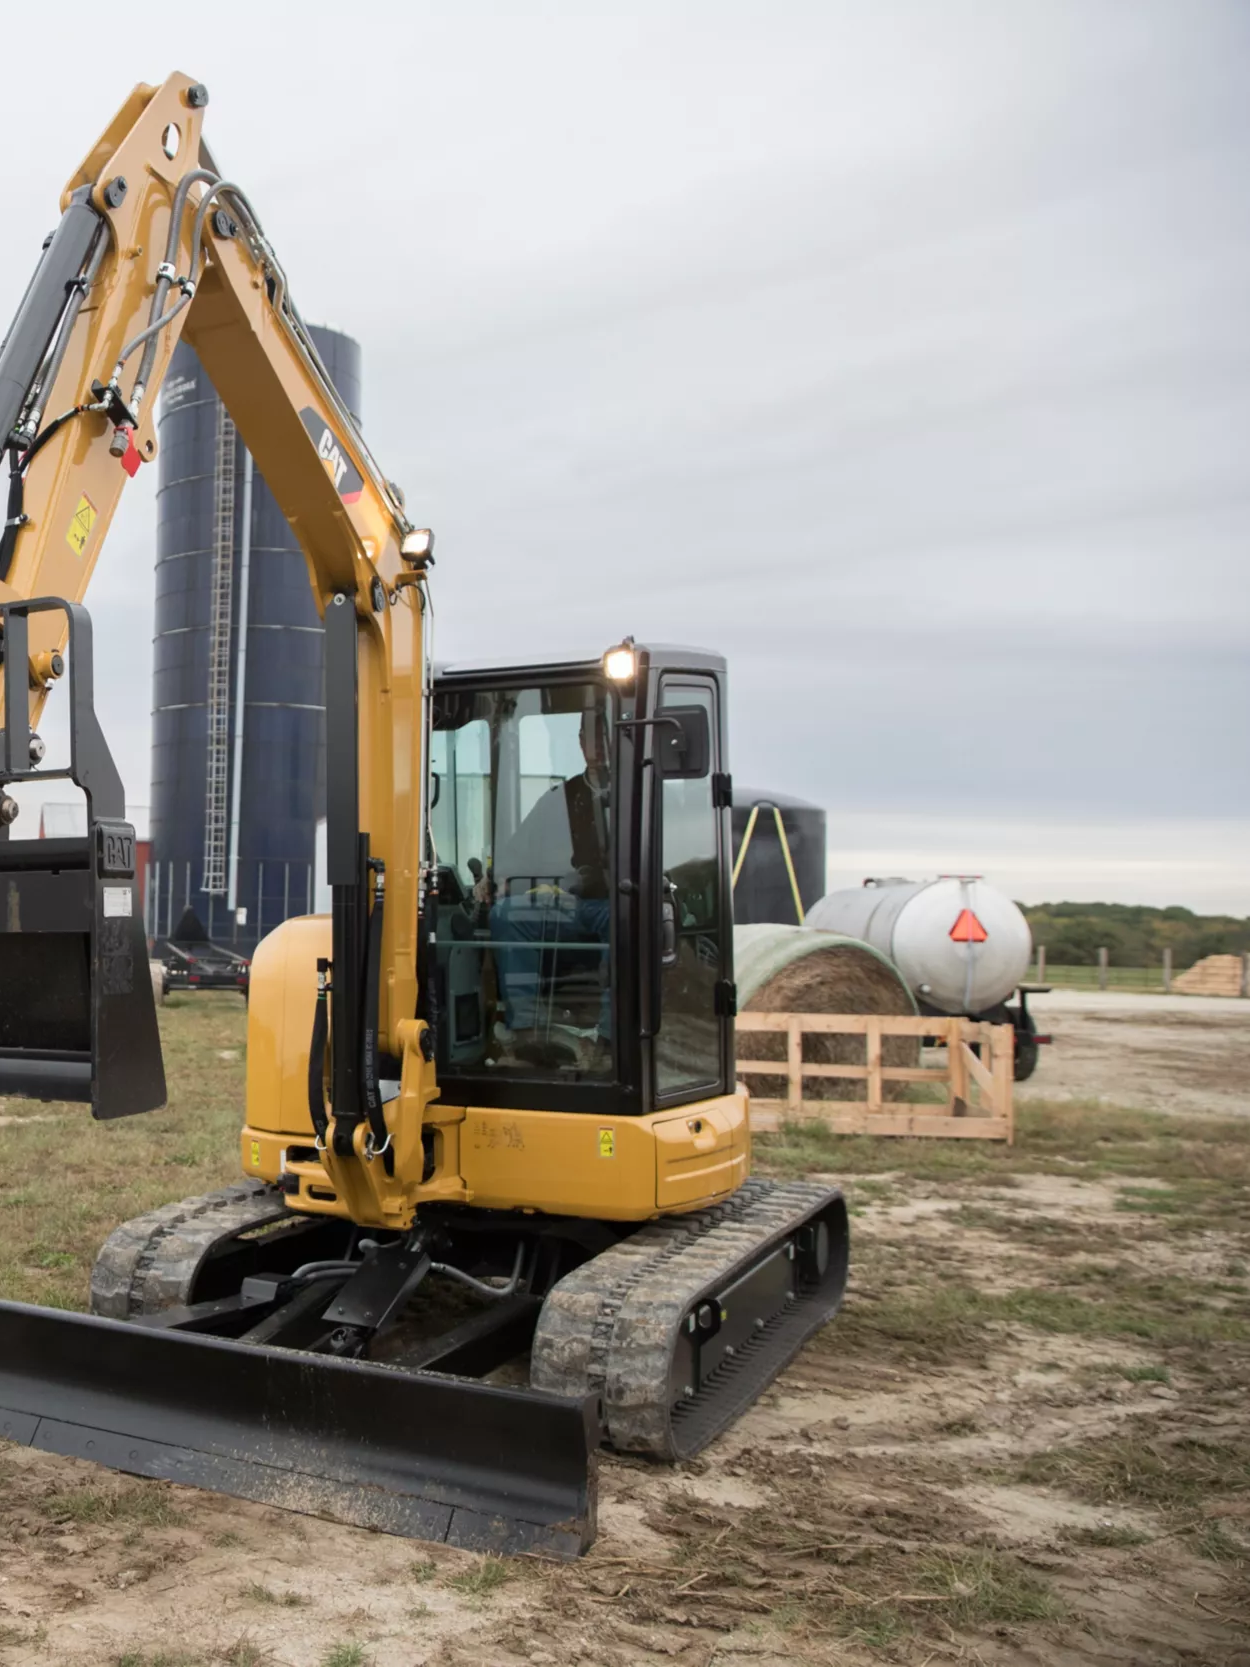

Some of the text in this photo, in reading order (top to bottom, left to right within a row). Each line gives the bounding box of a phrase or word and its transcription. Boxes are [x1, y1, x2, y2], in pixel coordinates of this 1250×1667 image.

[318, 428, 348, 489] CAT
[106, 836, 132, 869] CAT
[366, 1091, 377, 1109] CAT
